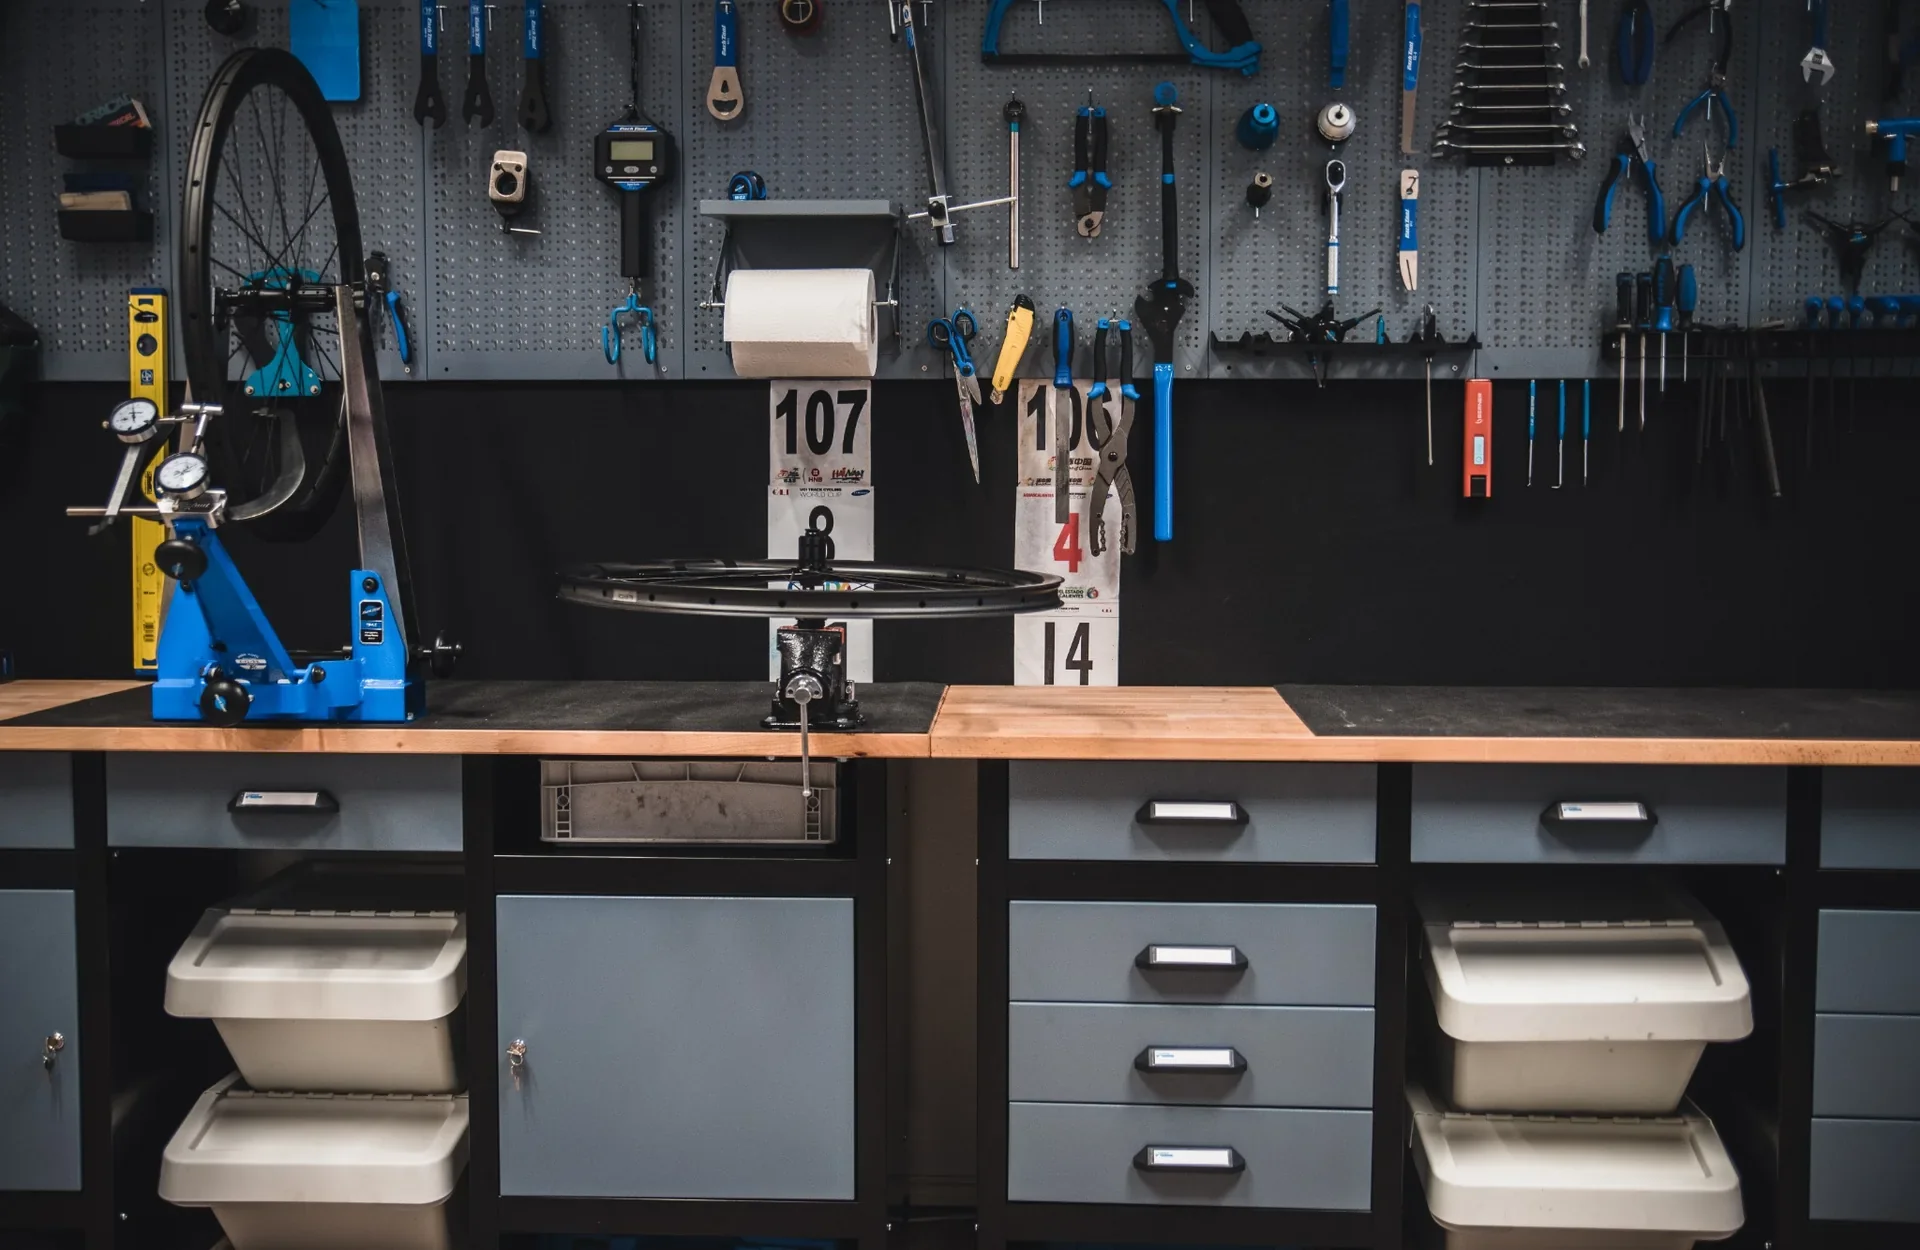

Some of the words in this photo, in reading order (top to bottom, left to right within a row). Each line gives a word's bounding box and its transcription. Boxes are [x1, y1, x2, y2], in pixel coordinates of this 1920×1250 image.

[775, 389, 868, 456] 107
[1053, 513, 1082, 573] 4
[1044, 622, 1093, 686] 14
